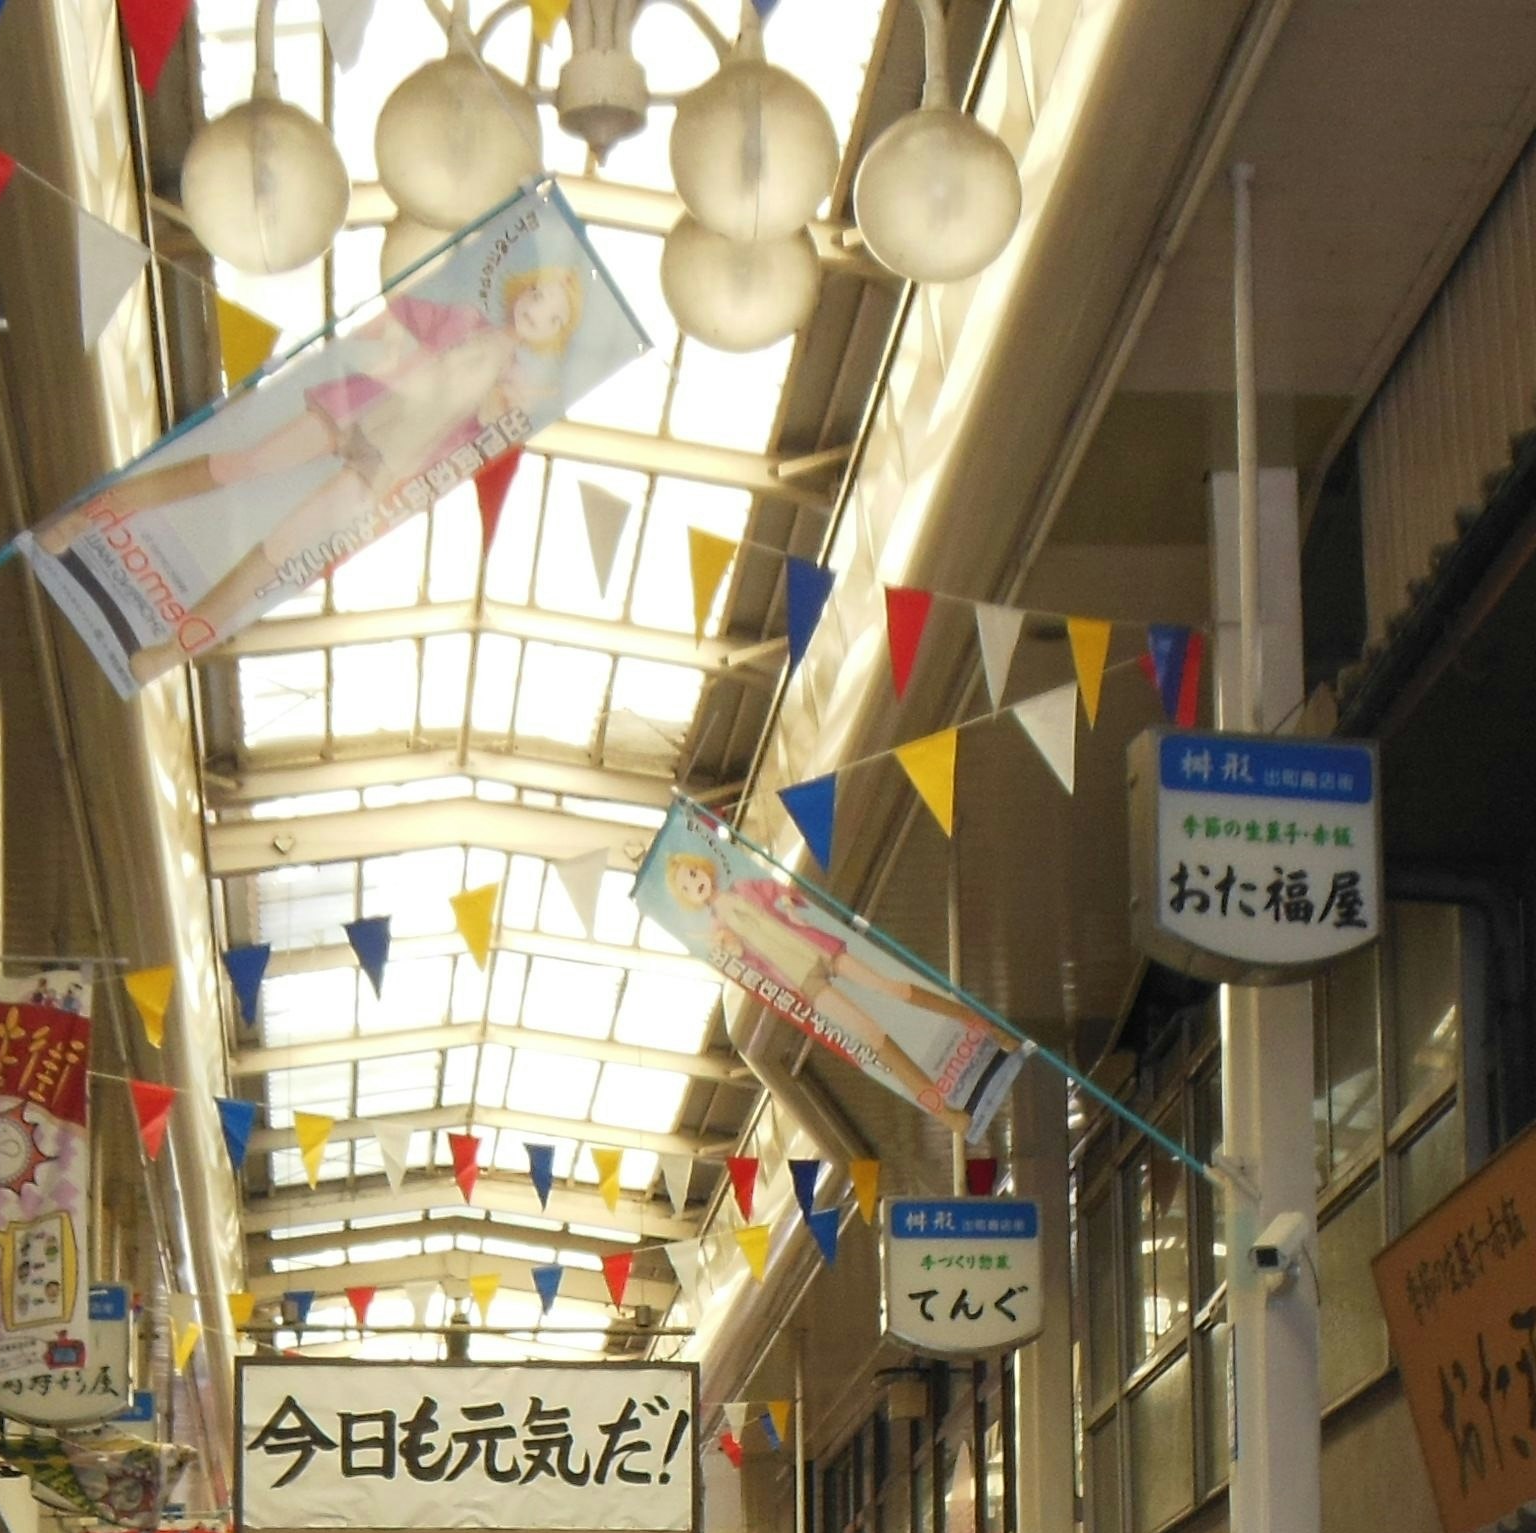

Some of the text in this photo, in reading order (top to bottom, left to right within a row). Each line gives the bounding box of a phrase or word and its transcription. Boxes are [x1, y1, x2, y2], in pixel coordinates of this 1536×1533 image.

[1169, 860, 1368, 929] おた福屋
[907, 1285, 1030, 1323] てんぐ
[245, 1394, 690, 1488] 今日も元気だ!
